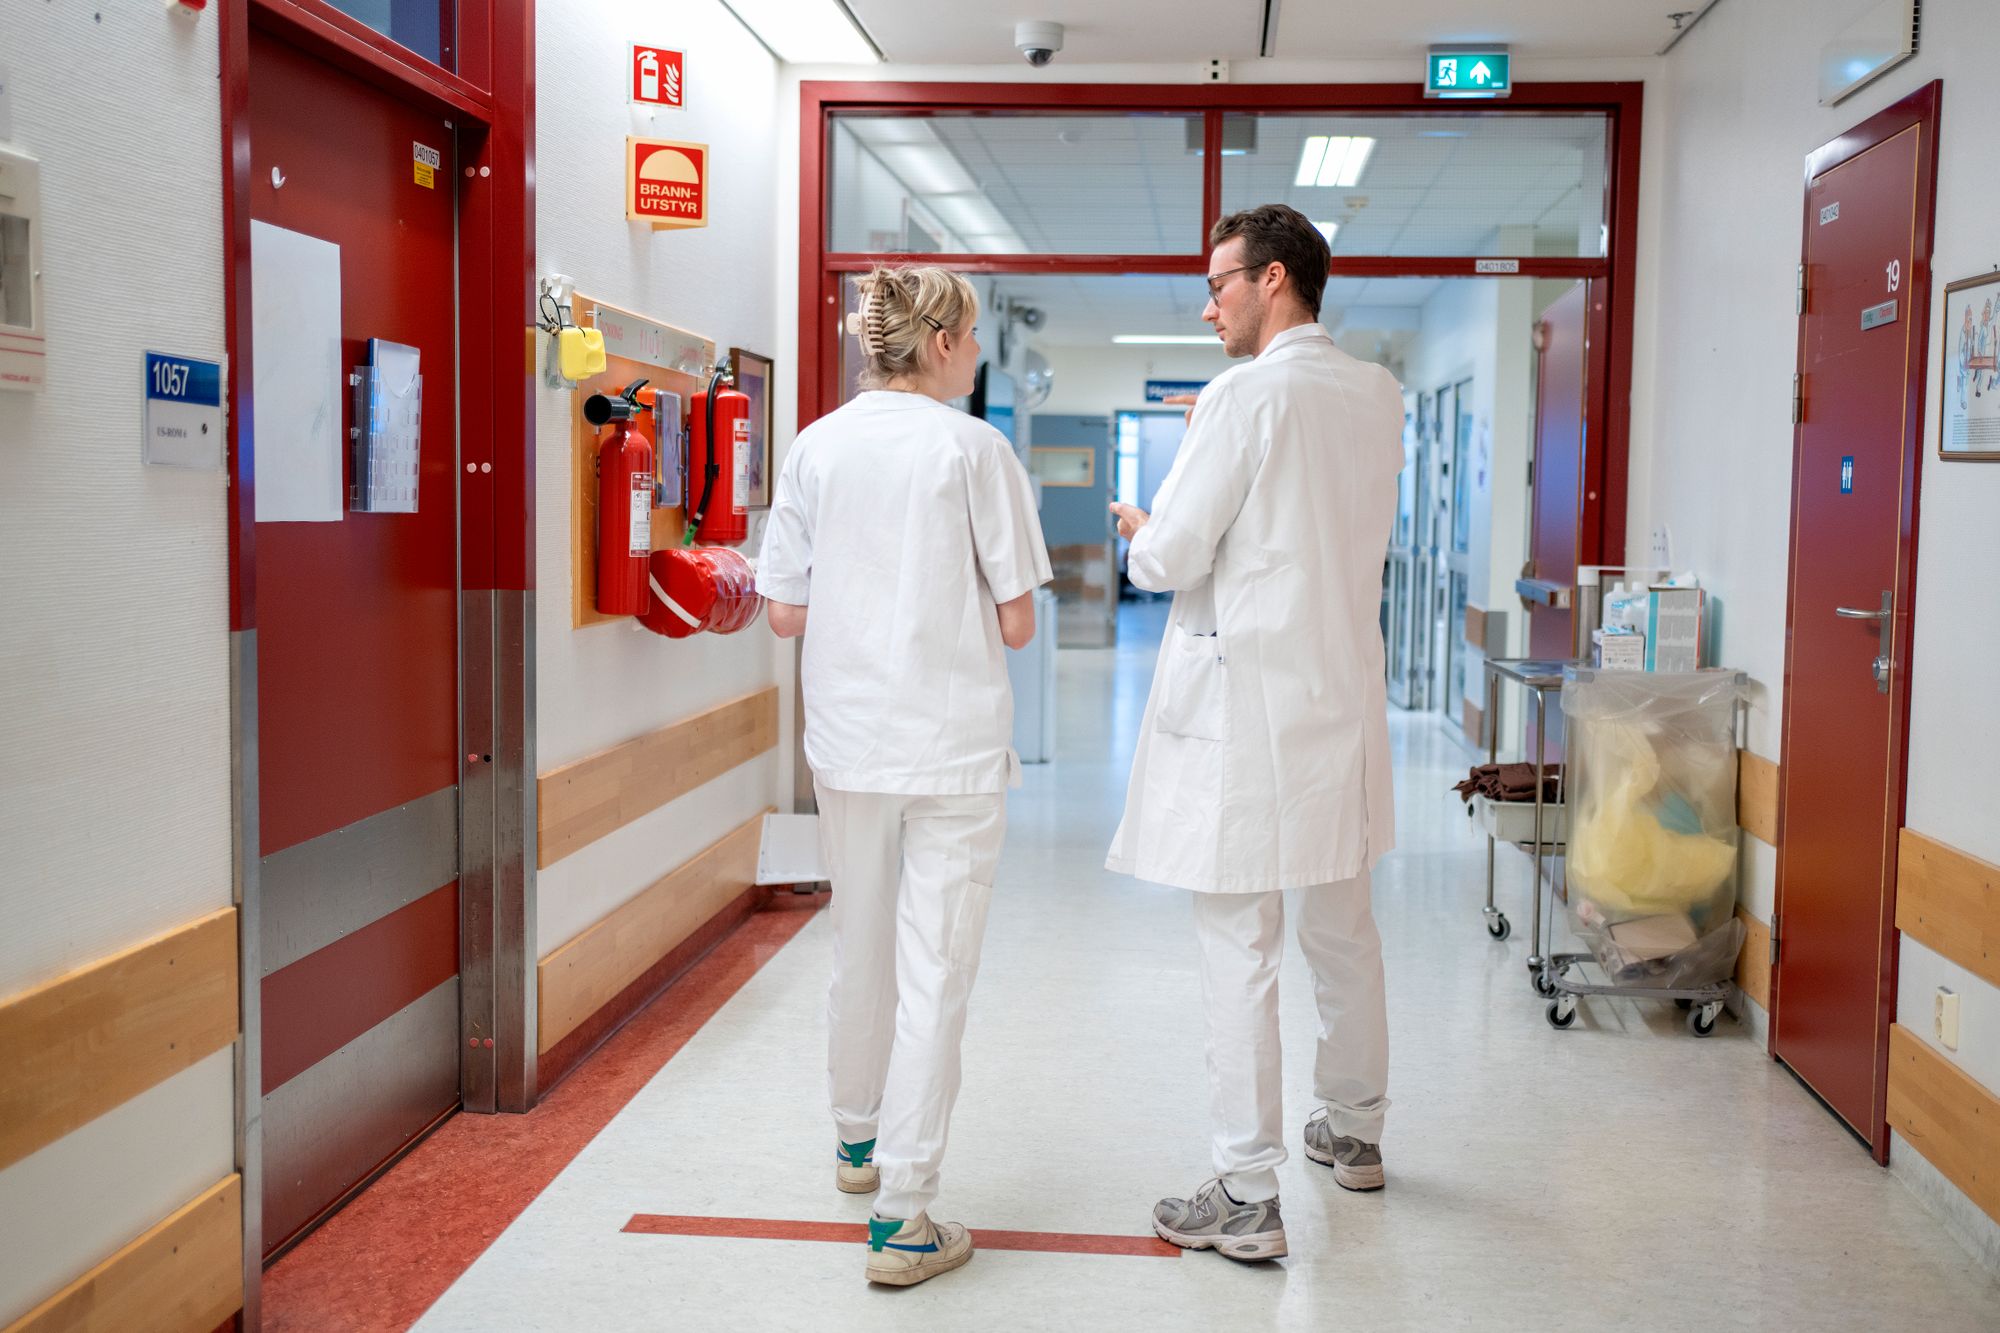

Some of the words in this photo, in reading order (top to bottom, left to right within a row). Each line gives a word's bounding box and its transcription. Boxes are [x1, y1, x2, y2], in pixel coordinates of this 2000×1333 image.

[414, 144, 439, 167] 0401057
[639, 183, 698, 199] BRANN-
[640, 198, 698, 213] UTSTYR
[1886, 259, 1900, 292] 19
[153, 361, 190, 396] 1057
